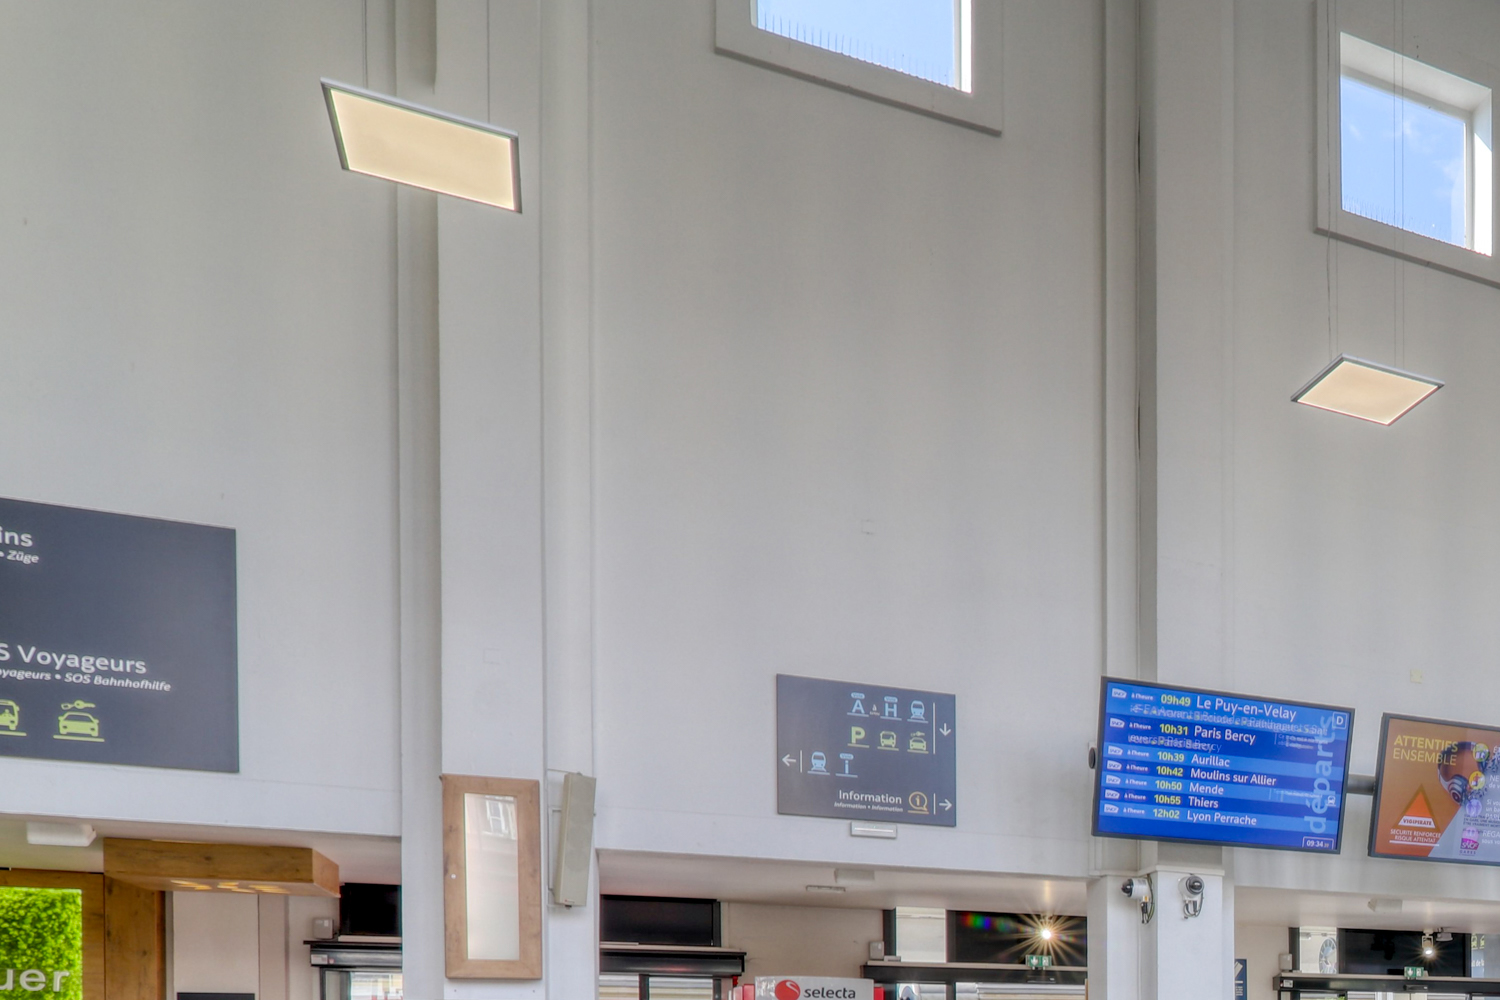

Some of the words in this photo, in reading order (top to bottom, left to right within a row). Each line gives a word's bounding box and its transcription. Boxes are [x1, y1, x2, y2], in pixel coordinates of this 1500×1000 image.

[7, 550, 39, 564] Züge
[17, 645, 146, 675] Voyageurs
[0, 668, 51, 681] yageurs
[65, 672, 91, 684] SOS
[94, 675, 171, 691] Bahnhofhilfe
[852, 699, 865, 714] A
[885, 703, 897, 717] H
[1161, 694, 1191, 706] 09h49
[1197, 695, 1211, 709] Le
[1215, 698, 1297, 722] Puy-en-Velay
[1336, 716, 1344, 725] D
[1160, 724, 1188, 735] 10h31
[1195, 725, 1221, 739] Paris
[1225, 729, 1256, 746] Bercy
[1394, 735, 1458, 753] ATTENTIFS
[1158, 752, 1184, 762] 10h39
[1192, 754, 1230, 767] Aurillac
[1393, 748, 1457, 766] ENSEMBLE
[1156, 766, 1183, 777] 10h42
[1191, 768, 1230, 781] Moulins
[1233, 775, 1248, 783] sur
[1250, 774, 1276, 786] Allier
[1304, 716, 1336, 833] départs
[1155, 780, 1182, 790] 10h50
[1189, 782, 1224, 795] Mende
[839, 790, 902, 804] Information
[1154, 795, 1181, 805] 10h55
[1188, 796, 1219, 808] Thiers
[834, 801, 866, 809] Information
[871, 804, 903, 812] Information
[1153, 809, 1180, 819] 12h02
[1187, 810, 1211, 822] Lyon
[1214, 813, 1257, 825] Perrache
[1403, 818, 1432, 826] VIGIPIRATE
[804, 987, 856, 999] selecta
